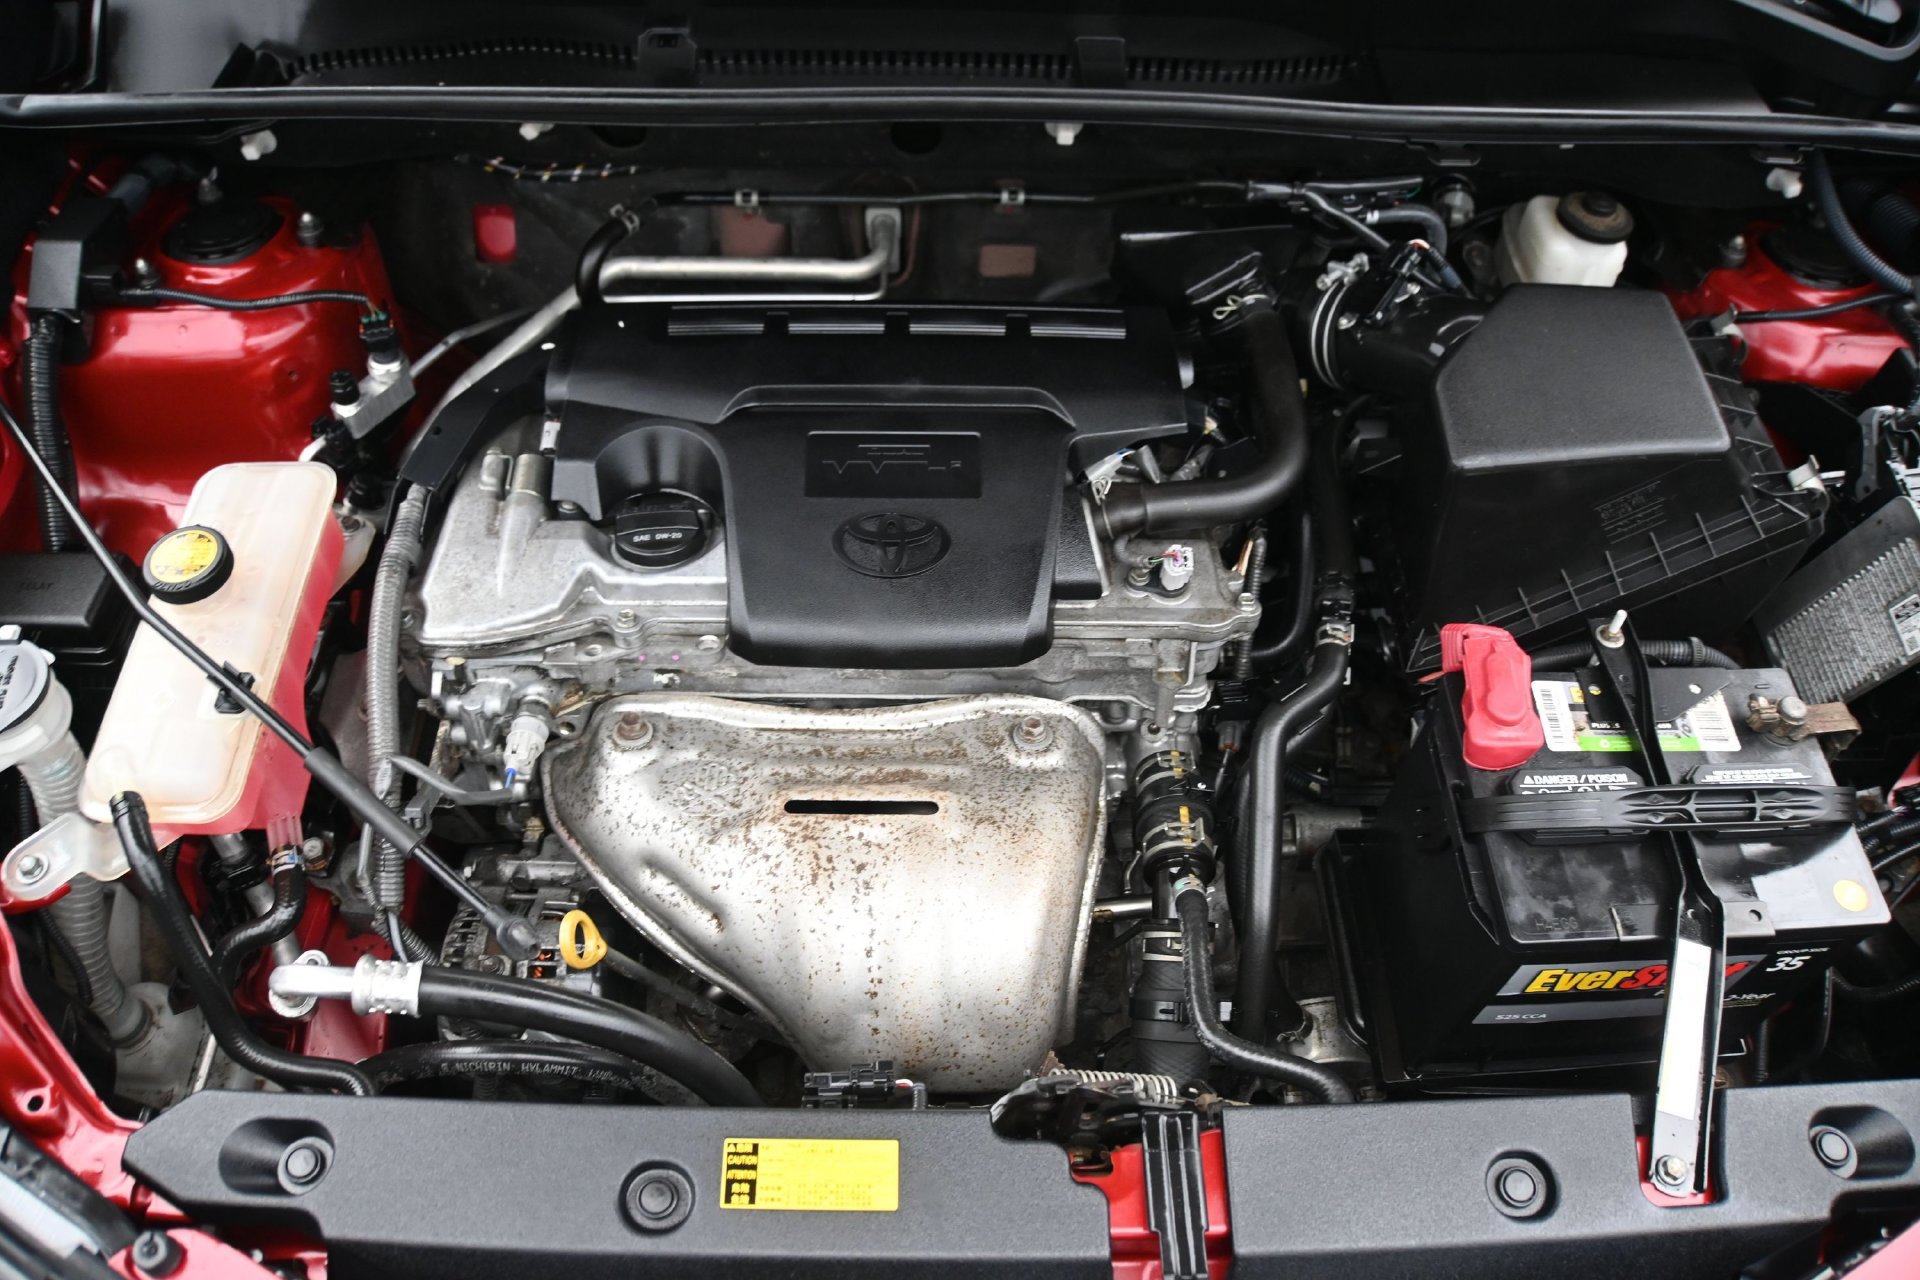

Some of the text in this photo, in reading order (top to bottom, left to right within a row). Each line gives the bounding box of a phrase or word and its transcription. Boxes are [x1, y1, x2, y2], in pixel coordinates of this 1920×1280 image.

[632, 534, 651, 543] SAE
[1534, 774, 1579, 785] DANGER
[1587, 773, 1629, 784] POISON
[1765, 955, 1812, 972] 35
[1521, 1012, 1547, 1020] CCA
[726, 1154, 759, 1166] CAUTION
